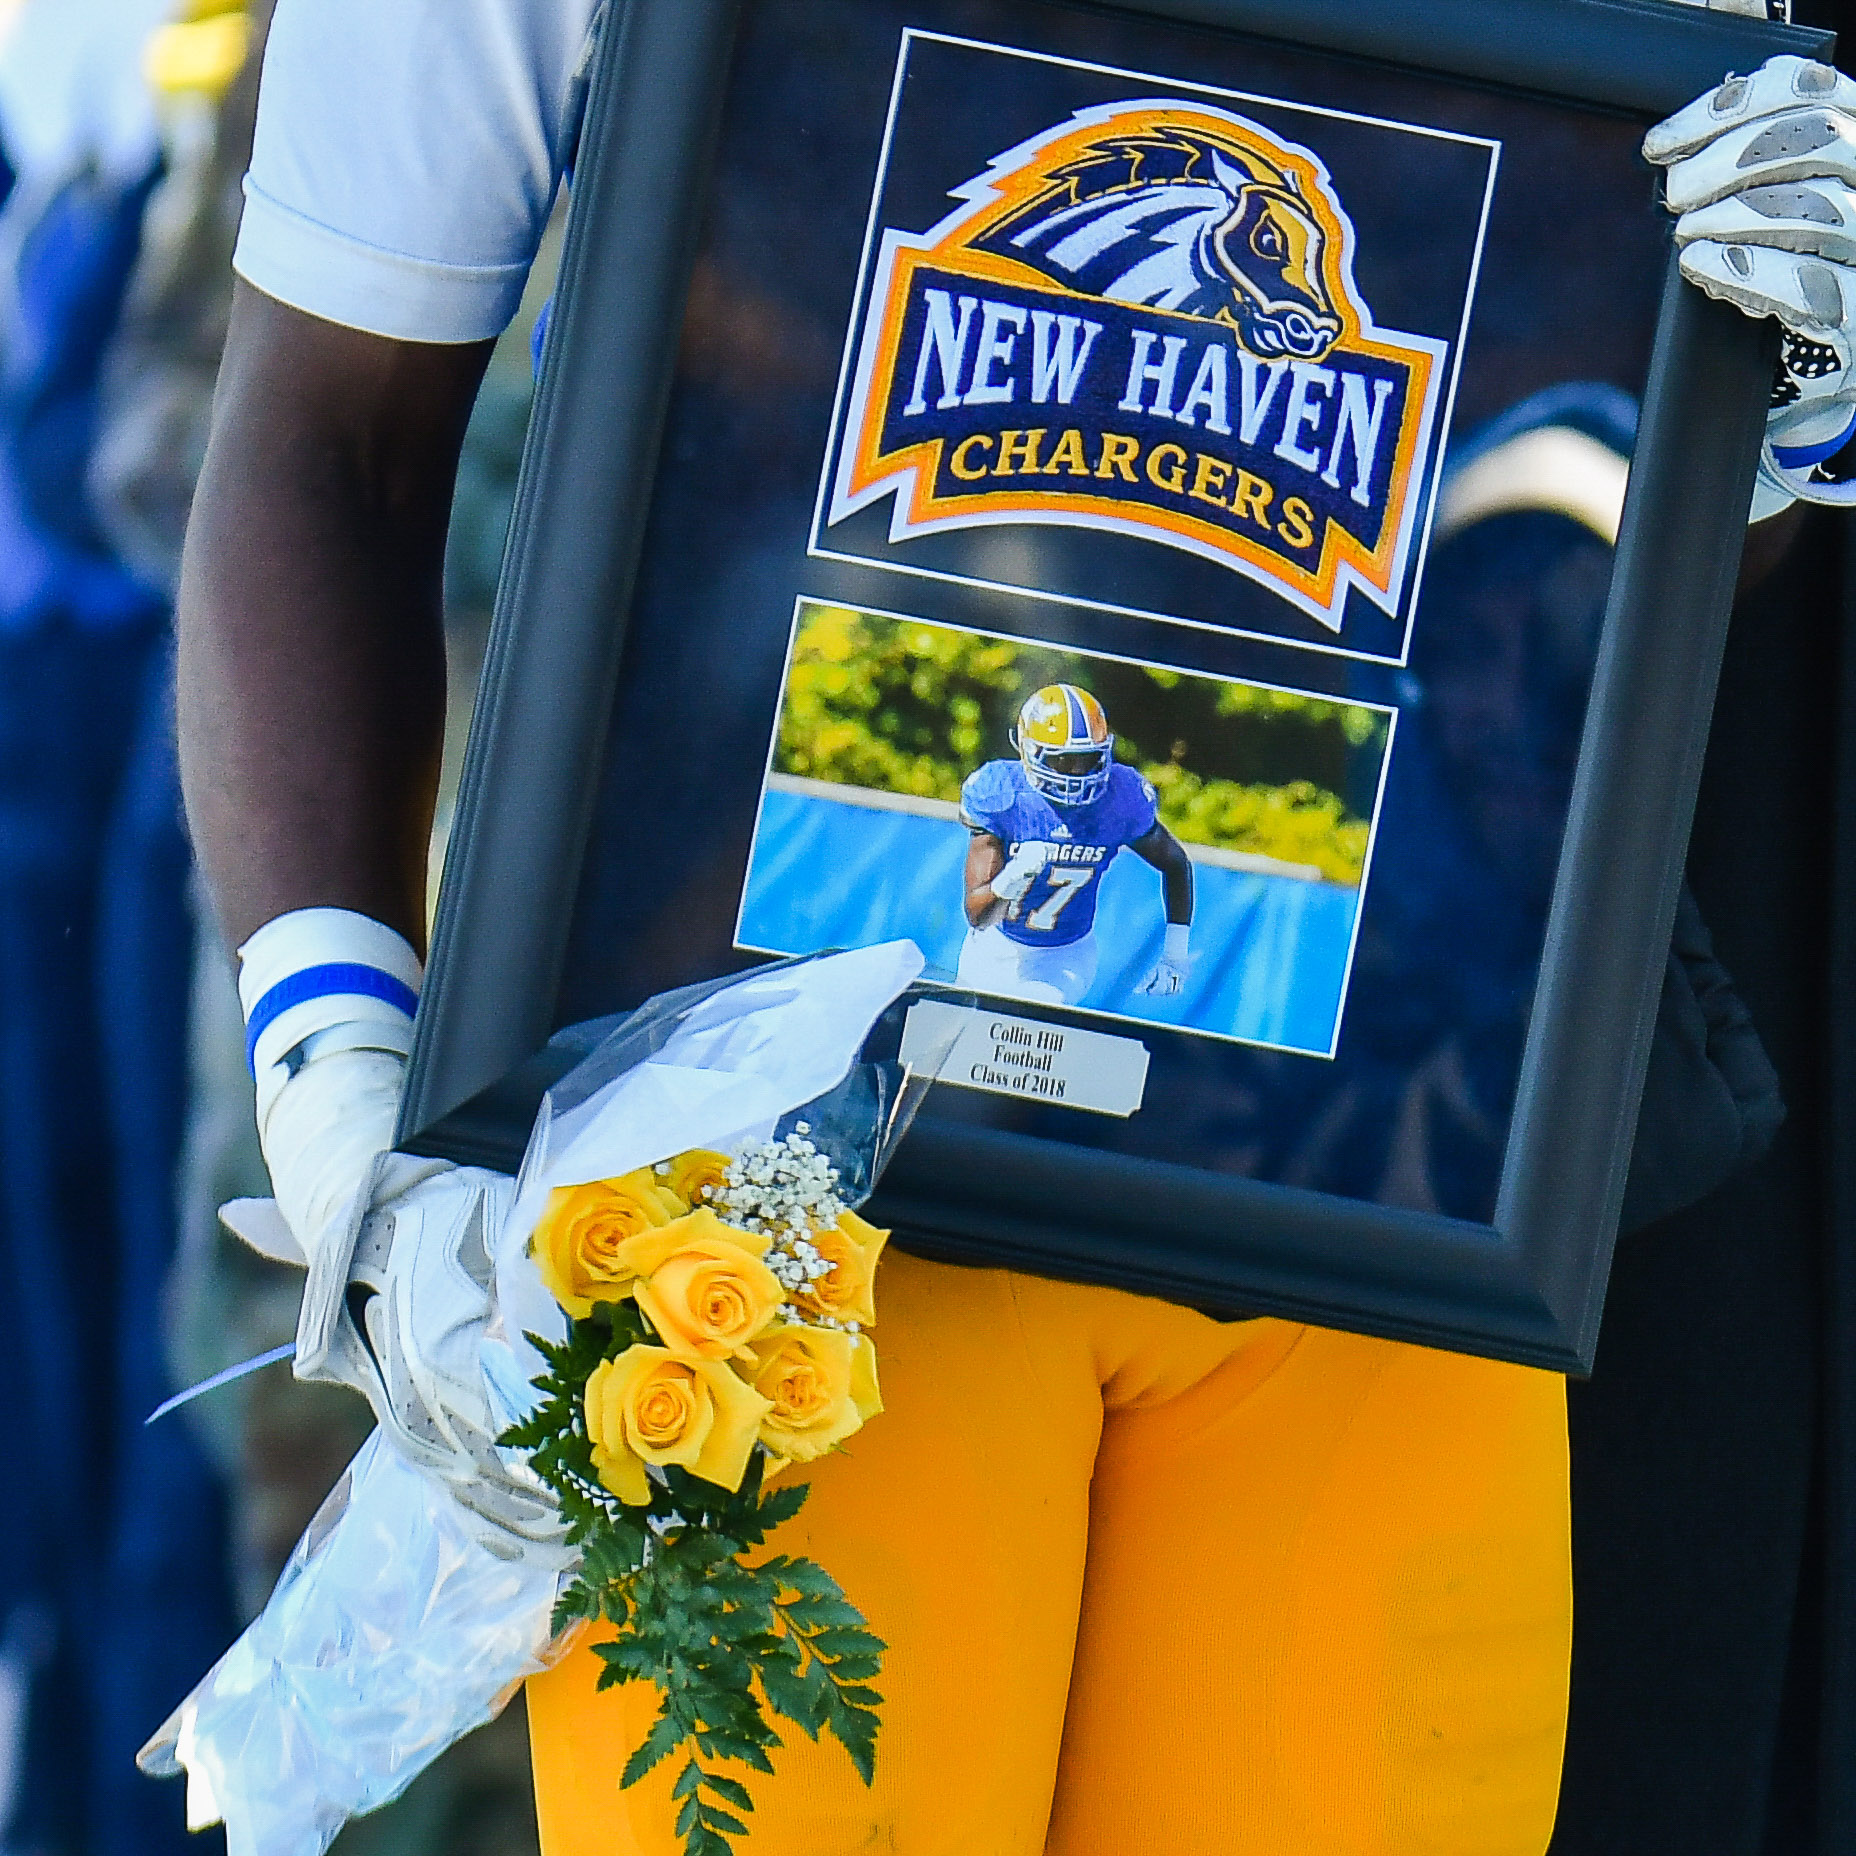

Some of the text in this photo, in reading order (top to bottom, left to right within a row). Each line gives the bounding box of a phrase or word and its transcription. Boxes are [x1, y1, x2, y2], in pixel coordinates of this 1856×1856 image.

[903, 288, 1394, 508] NEW HAVEN
[949, 428, 1318, 550] CHARGERS
[1009, 842, 1107, 862] CRGERS
[989, 1022, 1064, 1053] Collin Hill
[993, 1045, 1053, 1072] Football
[970, 1063, 1066, 1098] Class of 2018
